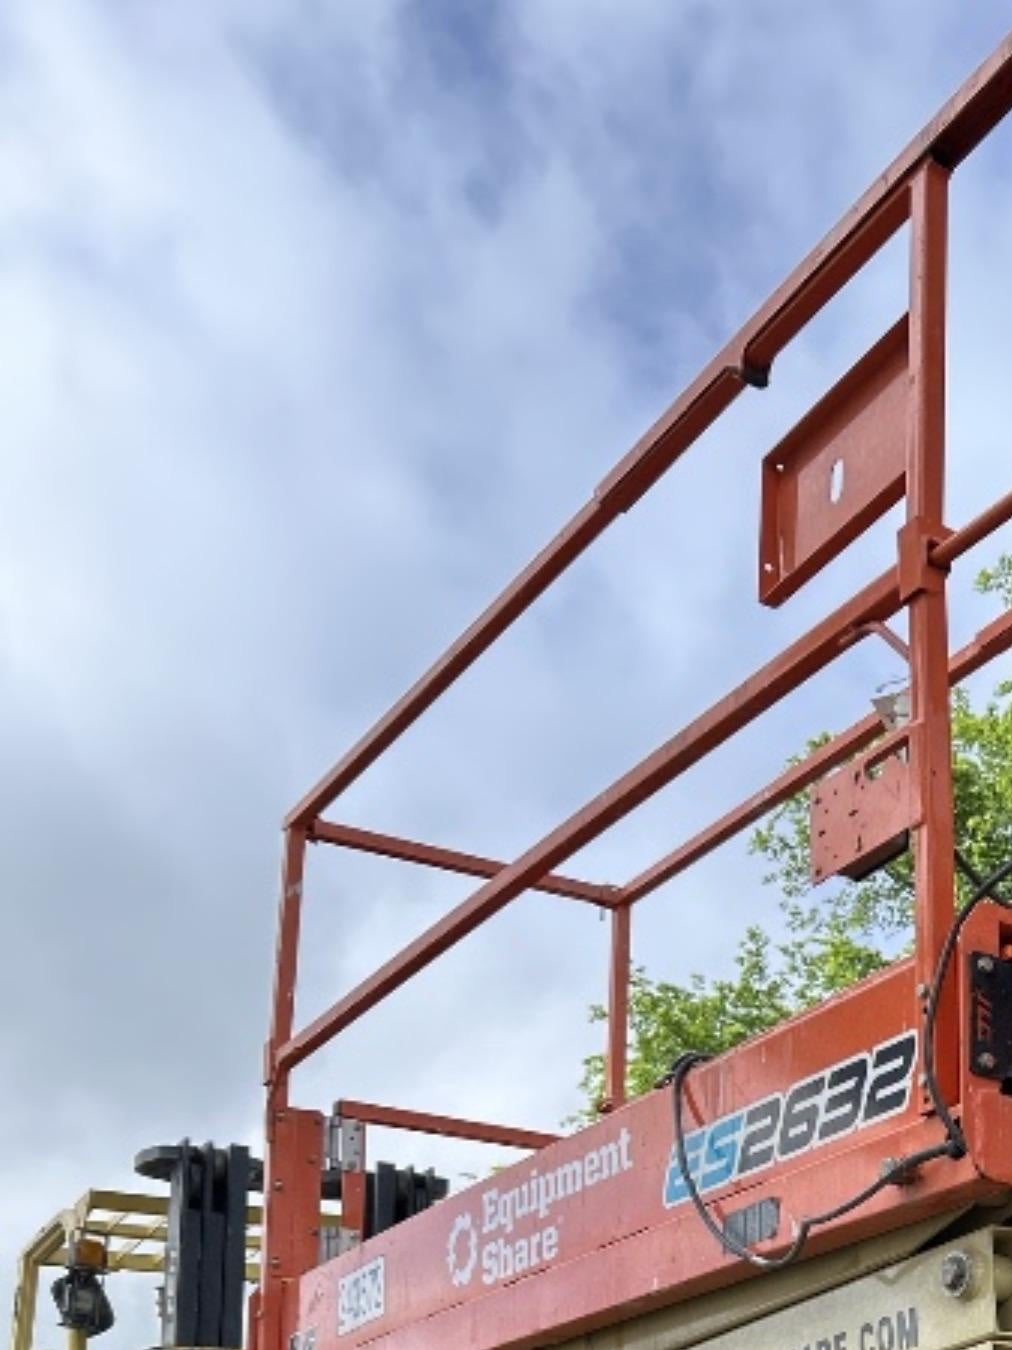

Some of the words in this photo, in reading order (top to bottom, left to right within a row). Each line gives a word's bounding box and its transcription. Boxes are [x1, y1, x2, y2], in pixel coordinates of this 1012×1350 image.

[663, 1028, 918, 1208] ES2632
[482, 1127, 633, 1233] Equipment
[482, 1224, 559, 1285] Share
